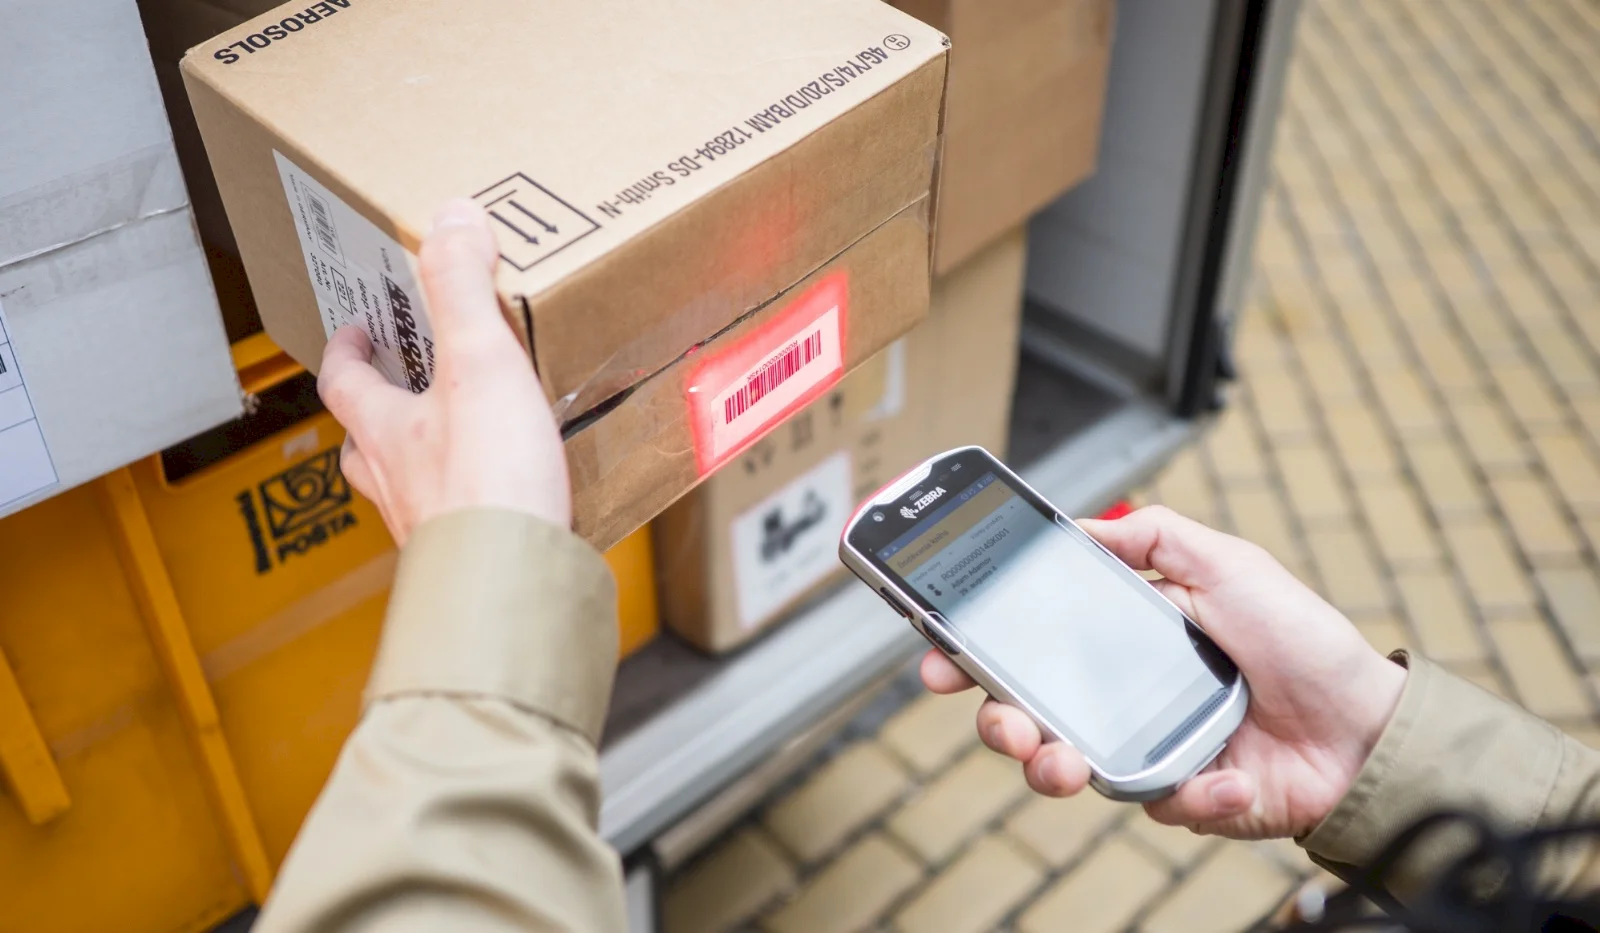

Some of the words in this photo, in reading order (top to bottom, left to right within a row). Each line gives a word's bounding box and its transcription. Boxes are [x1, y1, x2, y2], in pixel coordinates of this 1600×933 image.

[214, 0, 351, 64] AEROSOLS
[744, 46, 889, 133] 4G/Y4/S/20/D/BAM
[667, 126, 754, 177] 12894-DS
[597, 170, 676, 219] Smith-N
[336, 279, 348, 302] 221
[357, 277, 370, 310] deep
[365, 311, 380, 345] black
[395, 288, 430, 389] MOLOTO
[914, 486, 947, 511] ZEBRA
